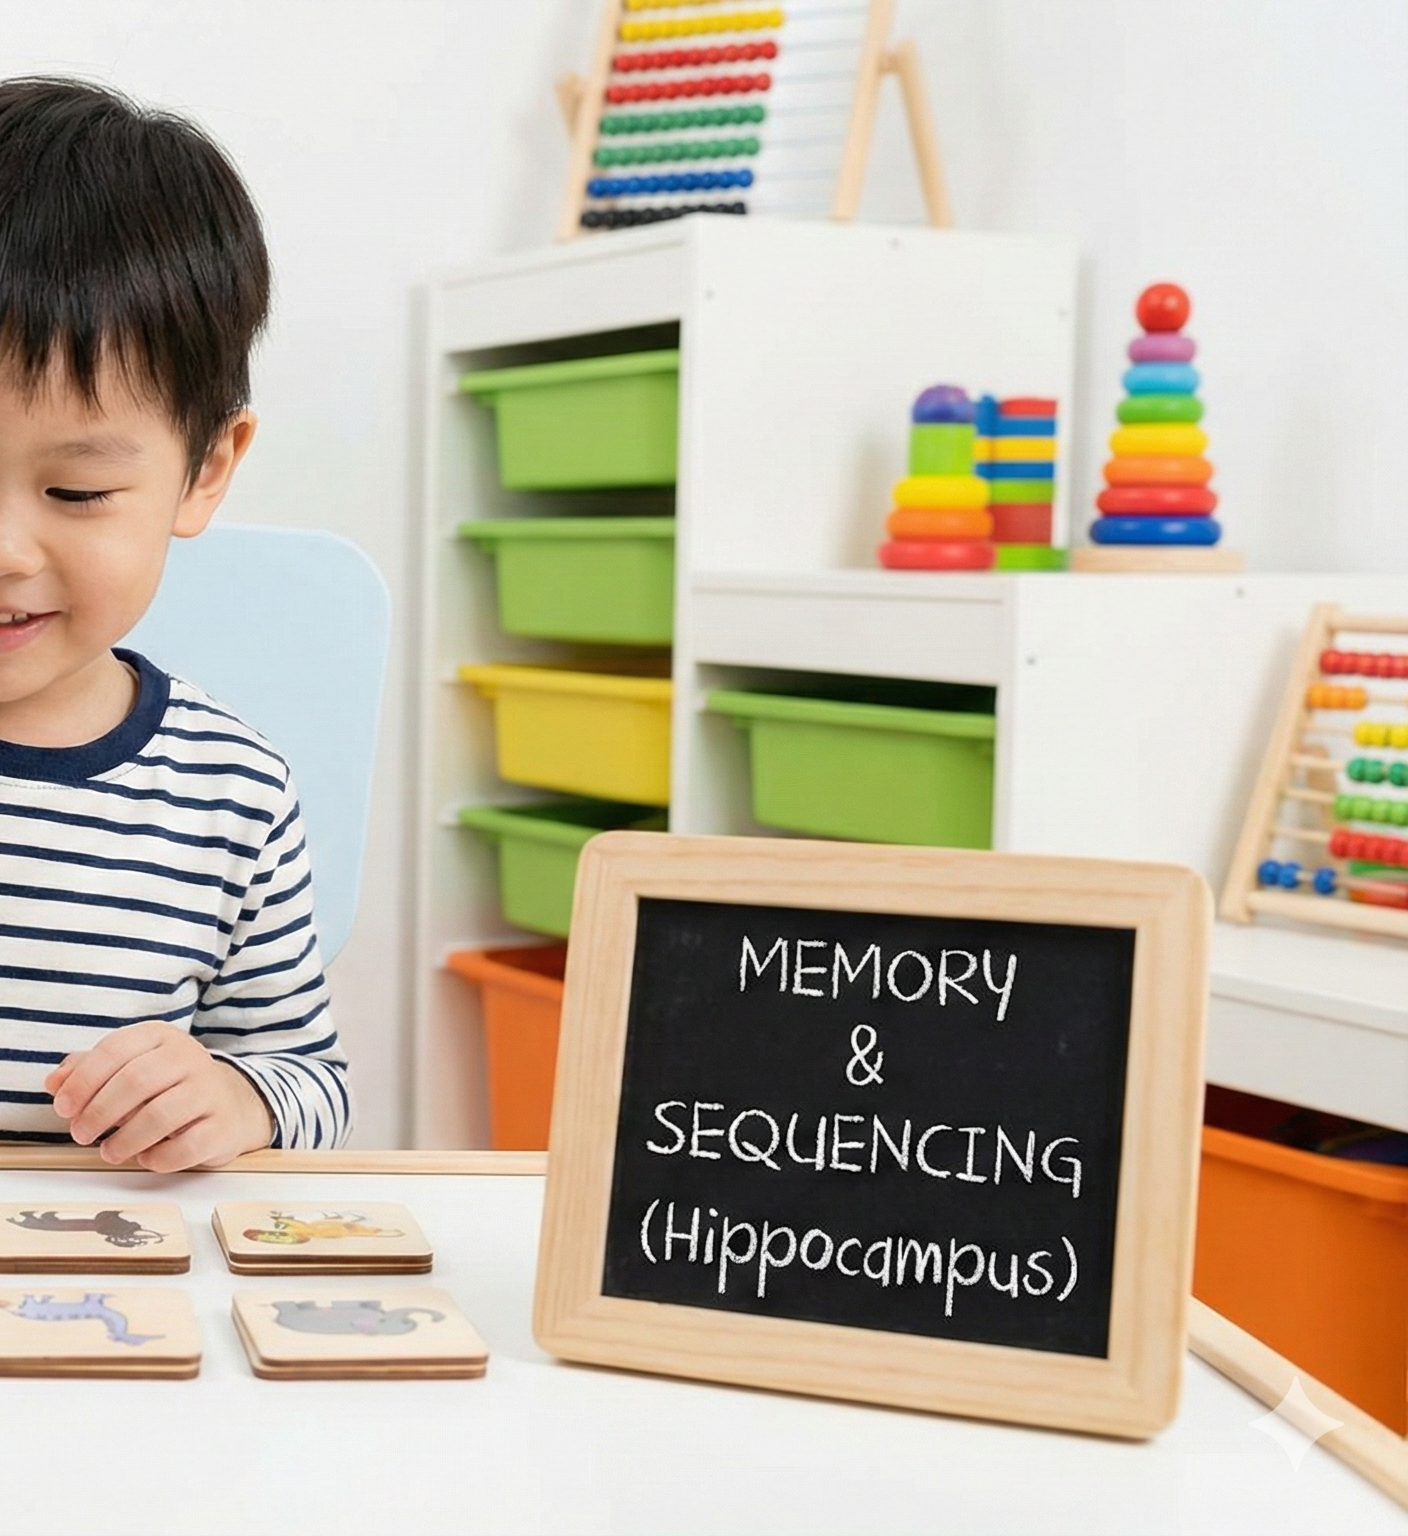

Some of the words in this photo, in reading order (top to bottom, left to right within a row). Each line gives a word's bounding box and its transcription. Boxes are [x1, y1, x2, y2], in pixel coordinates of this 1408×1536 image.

[739, 935, 1018, 1022] MEMORY
[845, 1024, 885, 1086] &
[645, 1100, 1083, 1199] SEQUENCING
[640, 1197, 1079, 1317] (Hippocampus)
